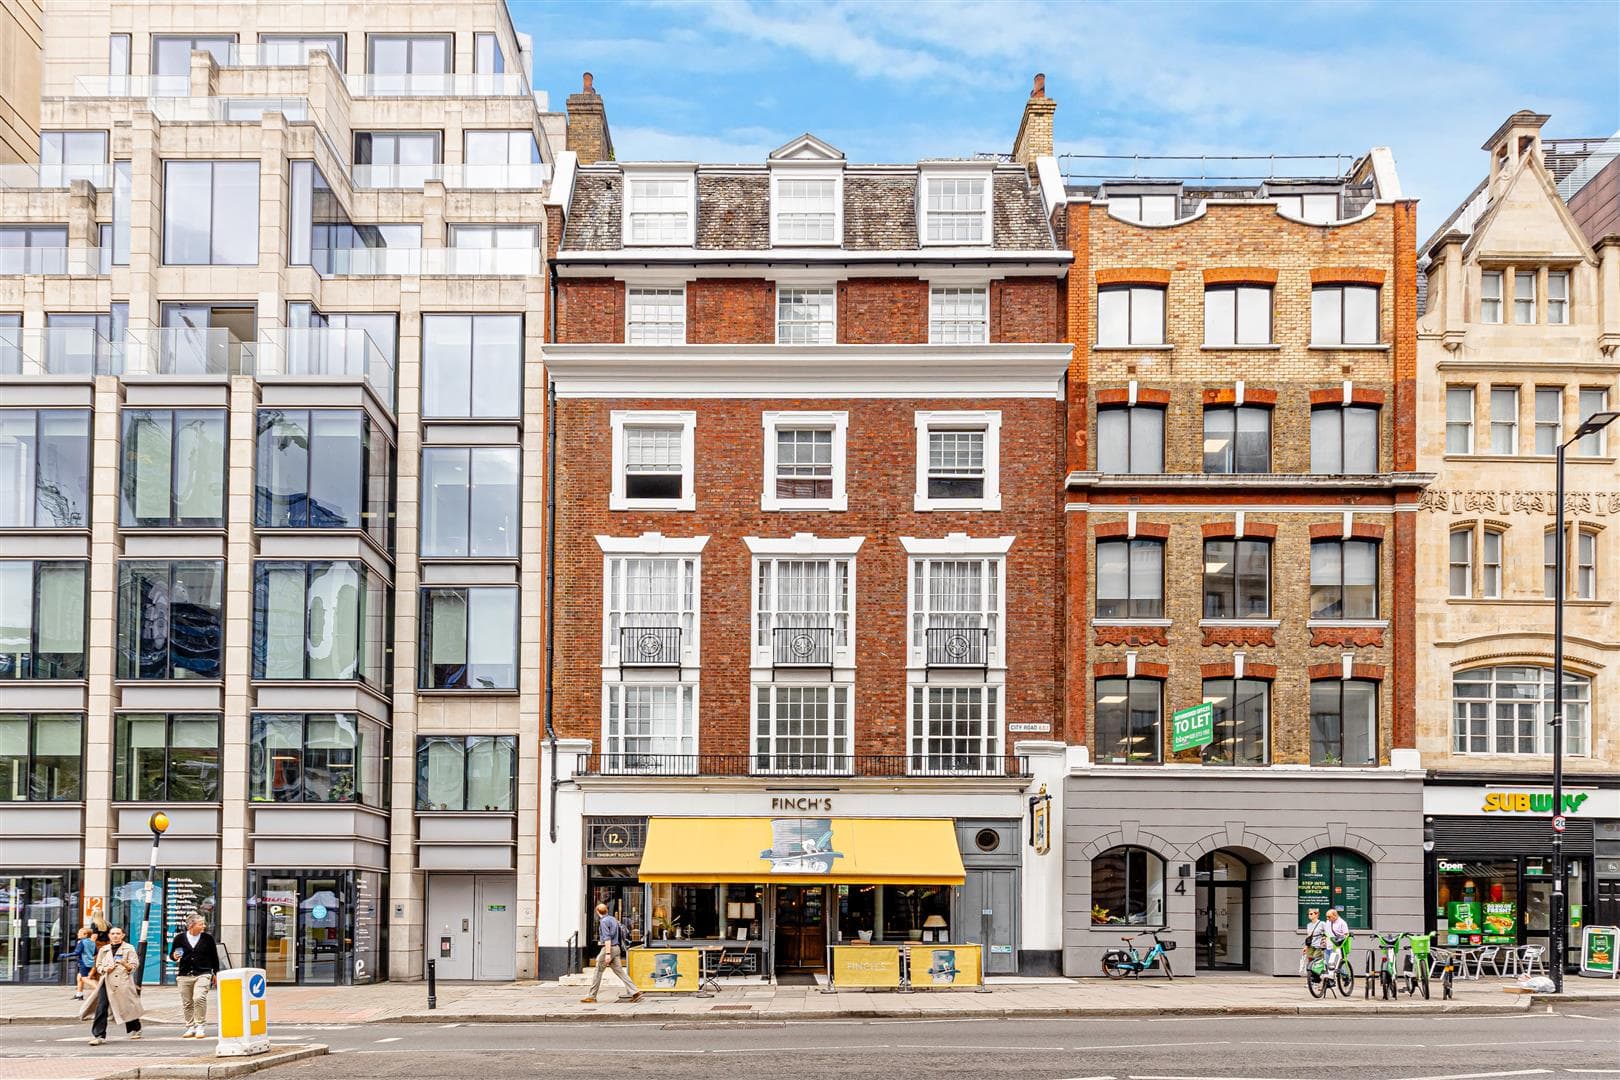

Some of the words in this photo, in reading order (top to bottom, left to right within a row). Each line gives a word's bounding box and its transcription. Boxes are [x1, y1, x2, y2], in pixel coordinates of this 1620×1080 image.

[1174, 720, 1190, 734] TO
[1192, 712, 1210, 730] LET
[772, 798, 832, 811] FINCH'S
[1439, 862, 1464, 871] Open
[1174, 880, 1186, 896] 4
[86, 898, 101, 910] 12
